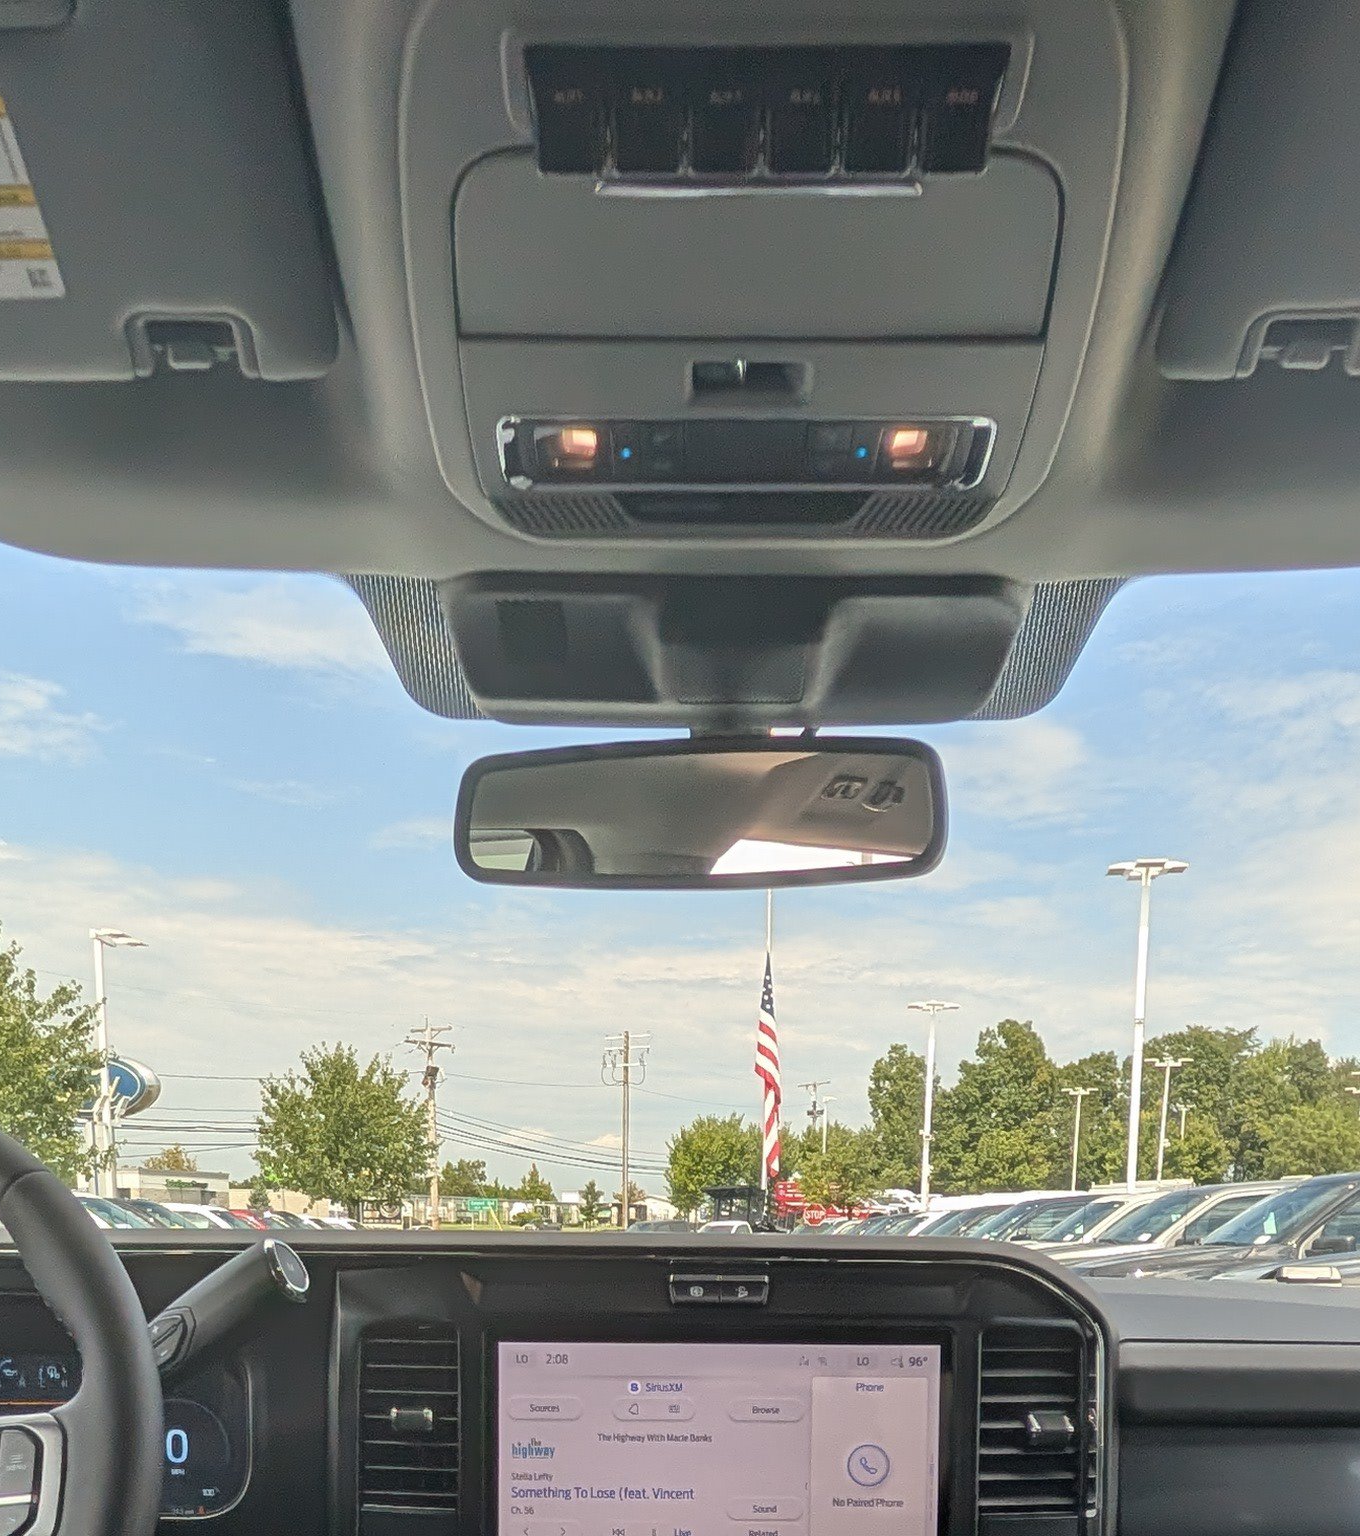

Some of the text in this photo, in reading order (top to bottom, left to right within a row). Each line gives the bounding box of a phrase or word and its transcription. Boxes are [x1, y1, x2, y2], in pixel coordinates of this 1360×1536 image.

[804, 1210, 825, 1220] STOP
[516, 1354, 569, 1365] LO 2:08
[856, 1356, 928, 1367] LO 96°
[645, 1382, 683, 1393] SiriusXM
[855, 1382, 884, 1393] Phone
[529, 1404, 560, 1413] Sources
[751, 1405, 780, 1415] Browse
[597, 1433, 612, 1442] The
[613, 1433, 645, 1444] Highway
[646, 1434, 666, 1442] With
[166, 1429, 188, 1463] 0
[511, 1442, 556, 1459] highway
[511, 1486, 695, 1501] Something To Lose (feat. Vincent
[833, 1498, 904, 1508] No Paired Phone
[752, 1504, 778, 1514] Sound
